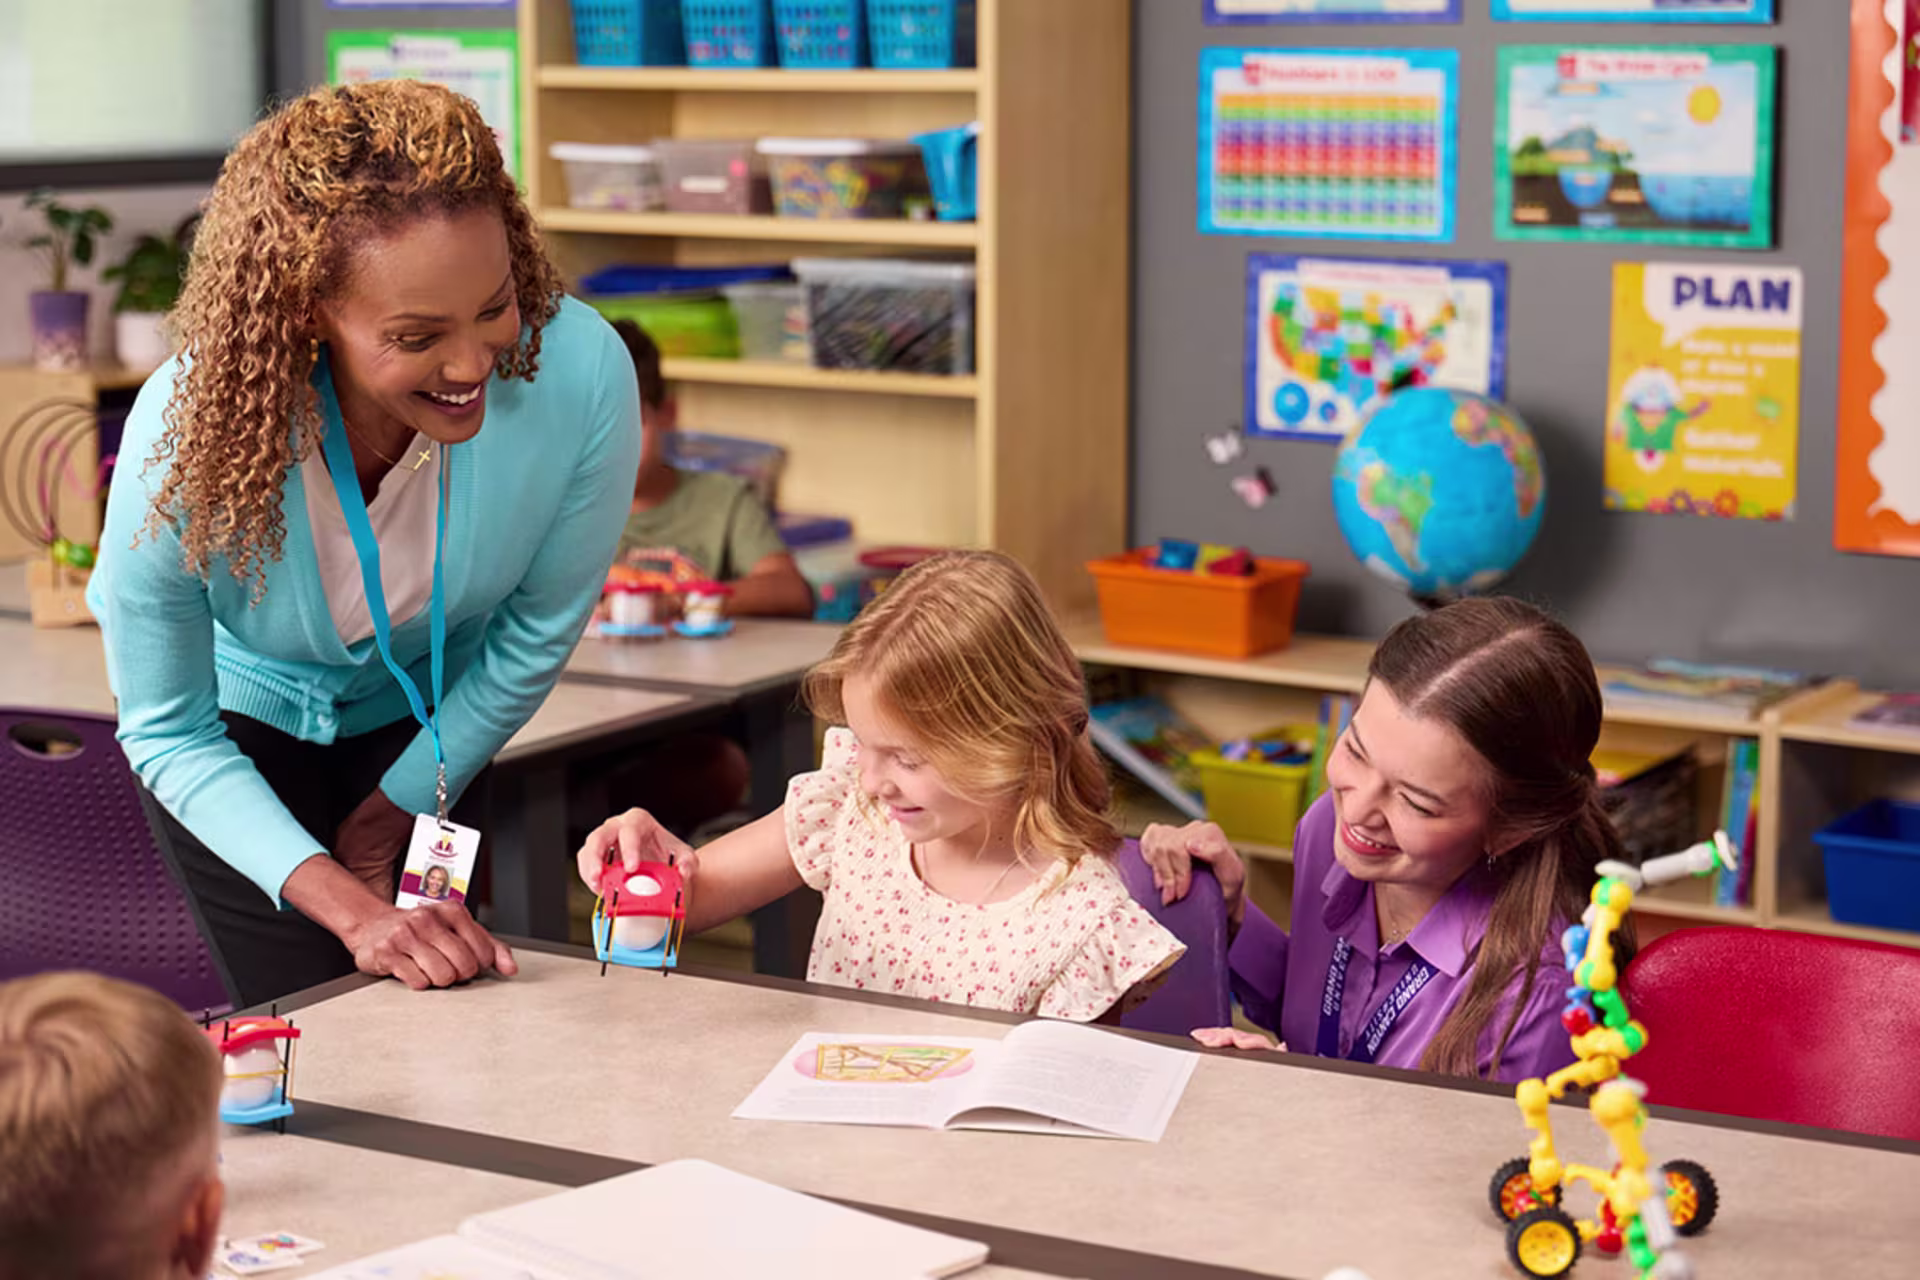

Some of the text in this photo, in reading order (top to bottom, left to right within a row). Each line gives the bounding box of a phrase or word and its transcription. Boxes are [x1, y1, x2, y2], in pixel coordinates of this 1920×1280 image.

[1674, 276, 1790, 310] PLAN
[1322, 964, 1338, 1017] GRAND
[1366, 966, 1430, 1056] GRAND CANYON
